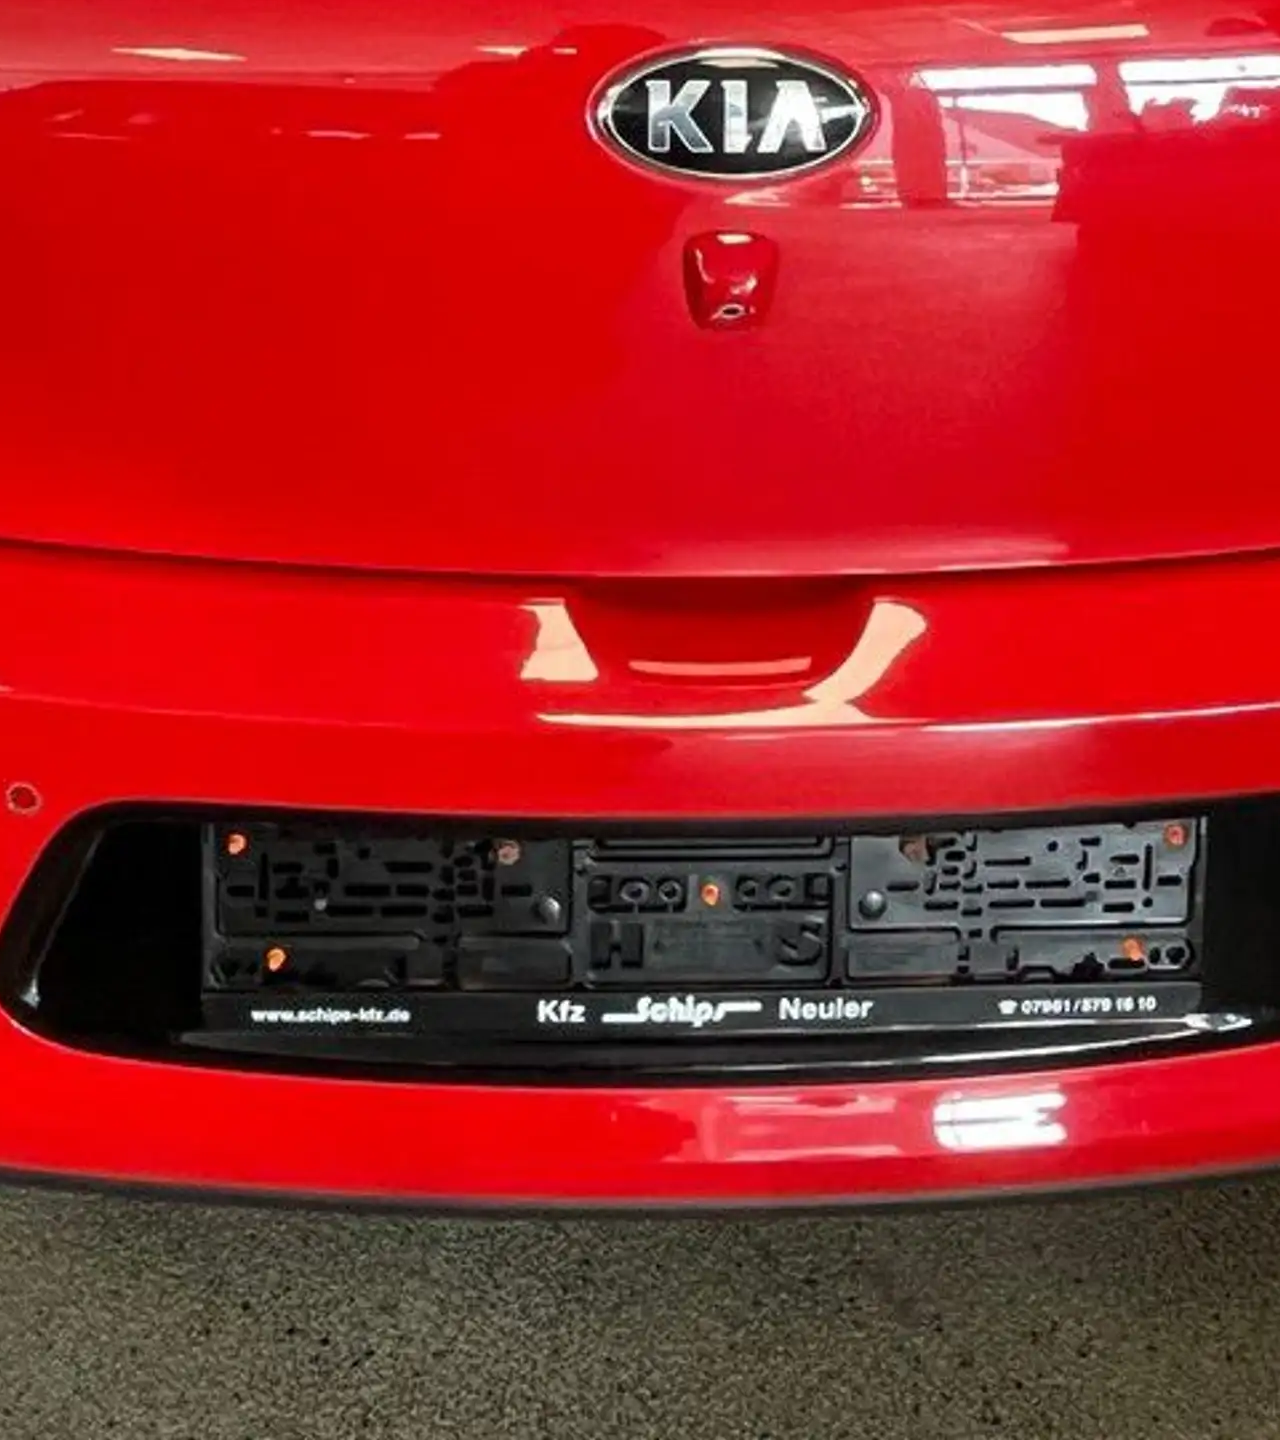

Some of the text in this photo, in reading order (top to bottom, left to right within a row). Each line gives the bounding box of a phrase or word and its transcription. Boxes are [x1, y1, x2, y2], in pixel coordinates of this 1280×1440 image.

[644, 78, 829, 155] KIA
[535, 994, 875, 1028] Kfz Schips Neuler
